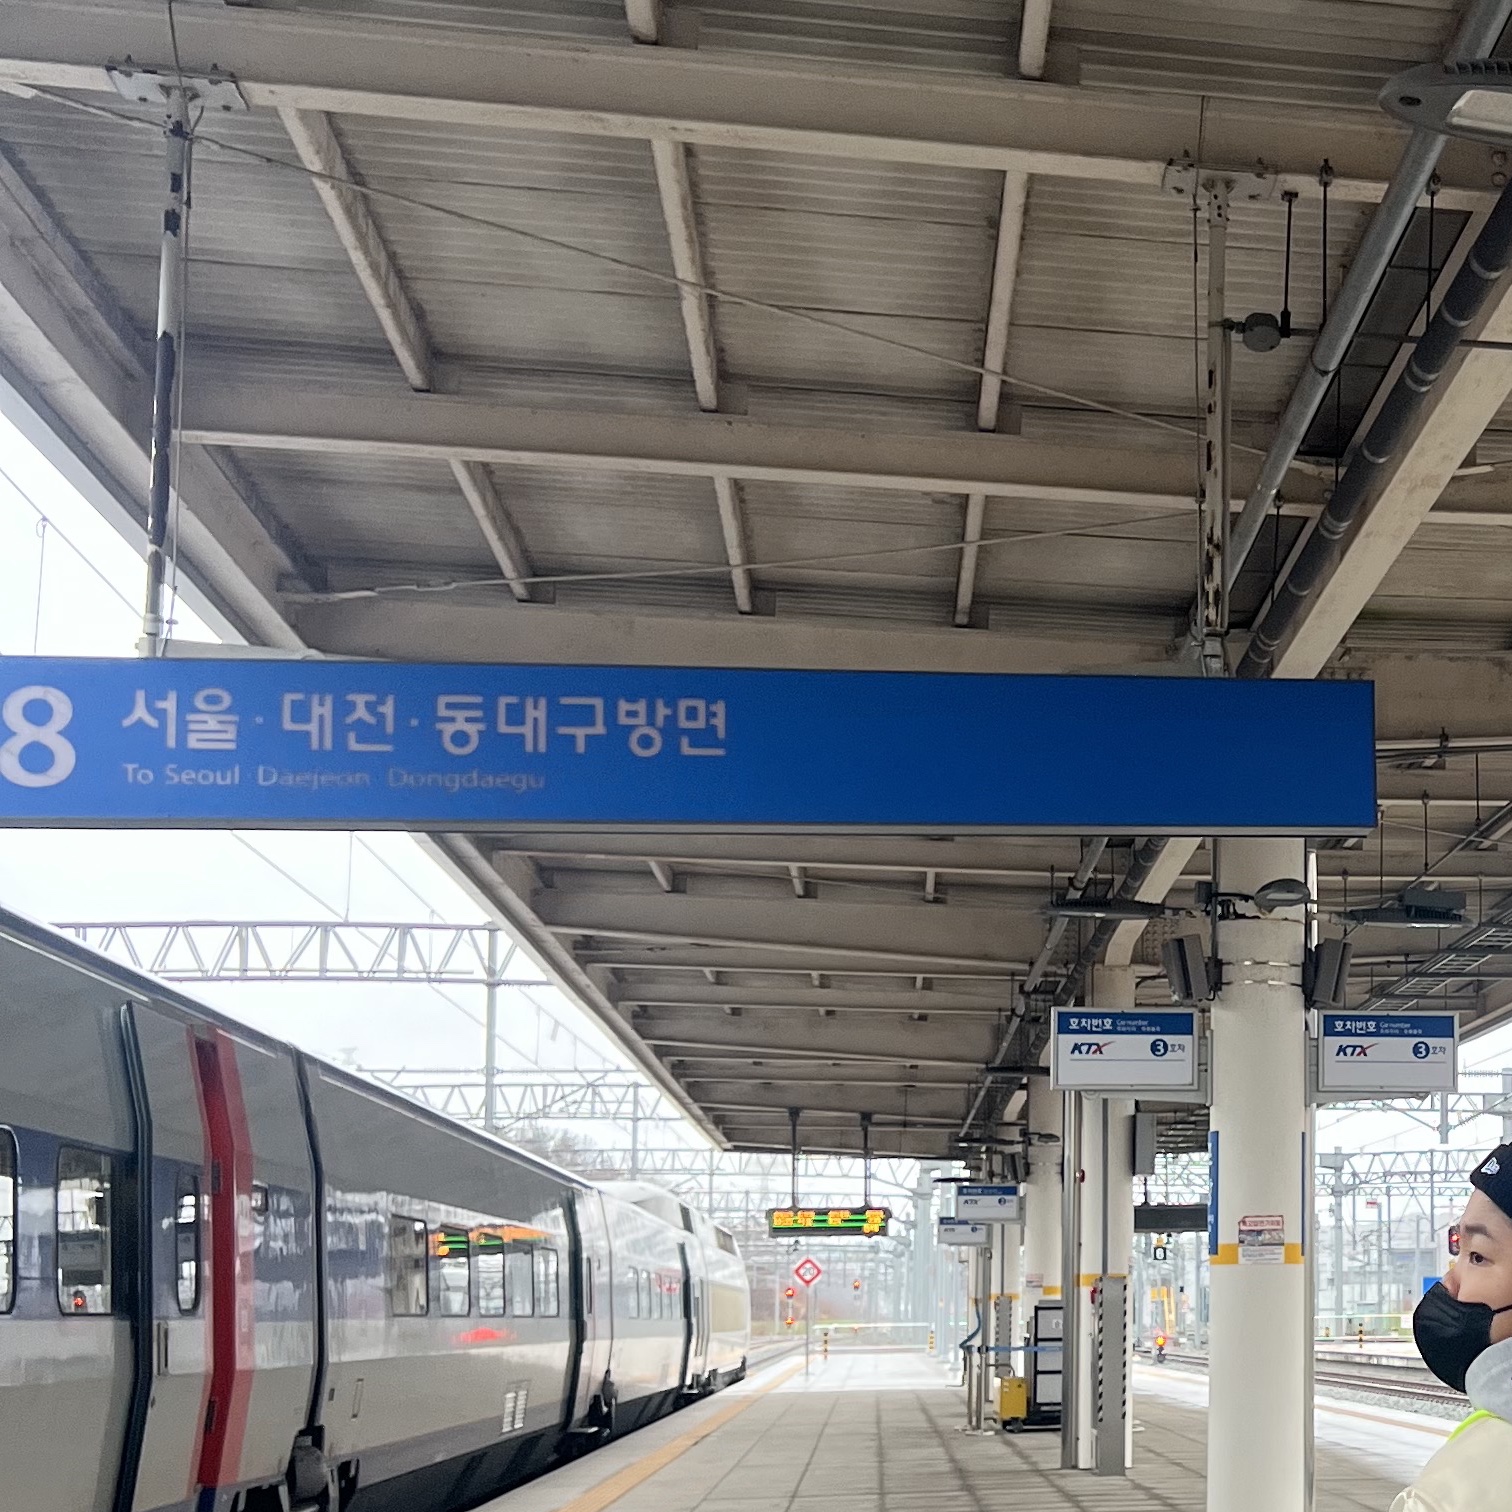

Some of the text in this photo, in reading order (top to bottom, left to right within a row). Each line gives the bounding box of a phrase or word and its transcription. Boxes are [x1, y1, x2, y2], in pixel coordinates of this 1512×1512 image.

[0, 685, 76, 788] 8
[123, 763, 154, 784] To
[165, 764, 240, 785] Seoul
[1070, 1041, 1115, 1055] KTX
[1335, 1043, 1379, 1057] KTX
